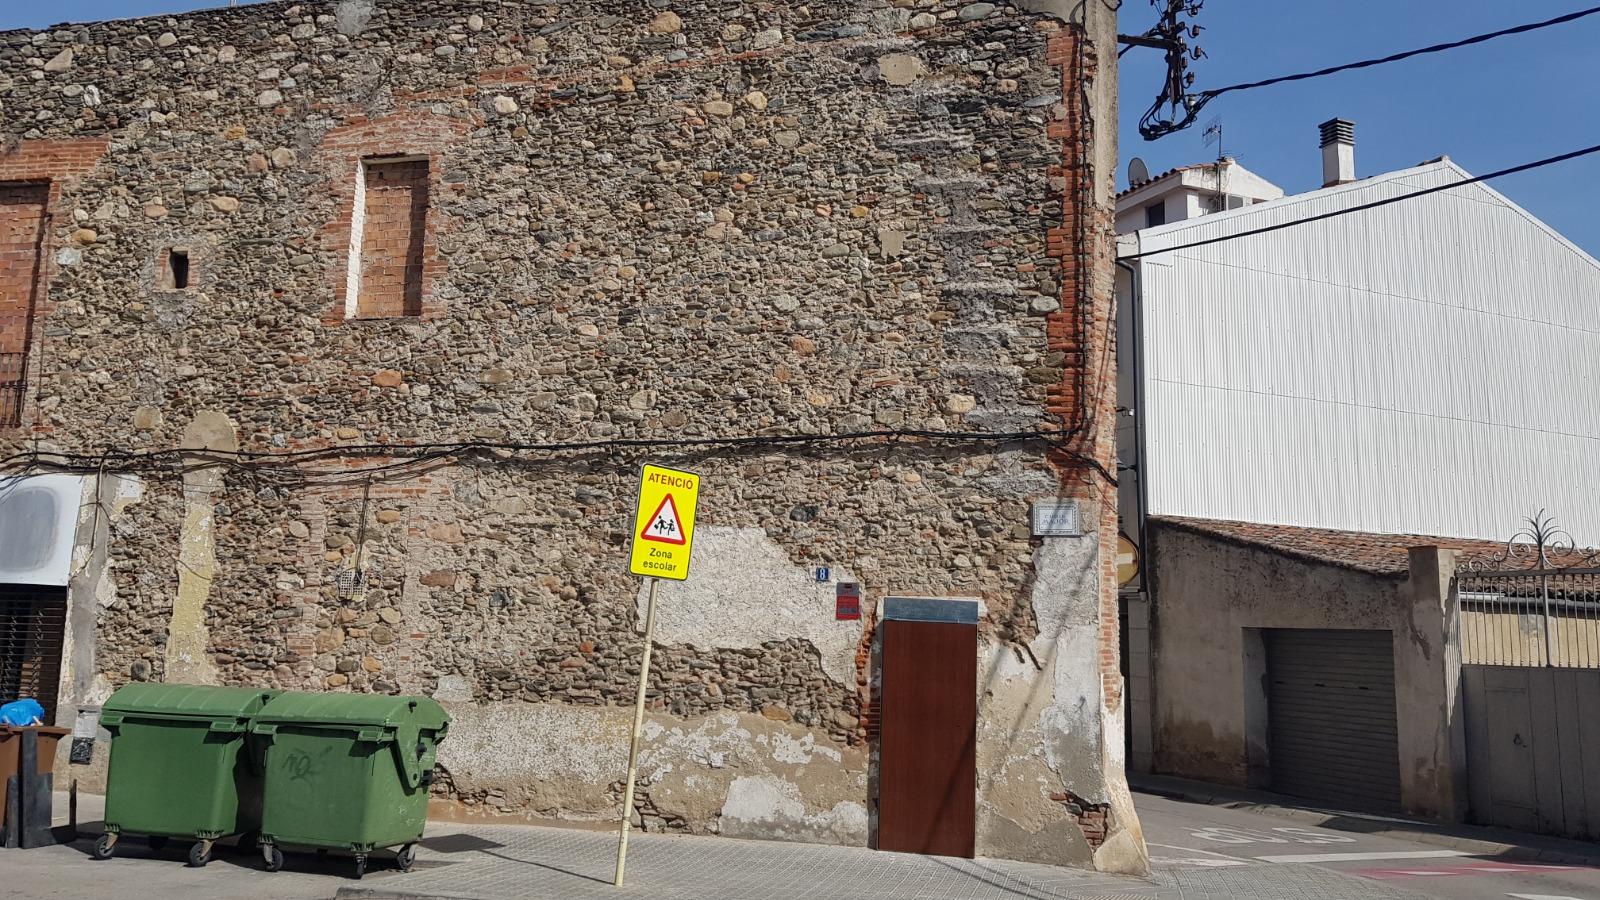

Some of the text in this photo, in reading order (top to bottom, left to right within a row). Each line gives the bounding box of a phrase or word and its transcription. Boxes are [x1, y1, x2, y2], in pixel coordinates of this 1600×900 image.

[648, 473, 693, 490] ATENCIÓ
[649, 547, 673, 559] Zona
[643, 560, 677, 572] escolar
[820, 568, 826, 580] 8
